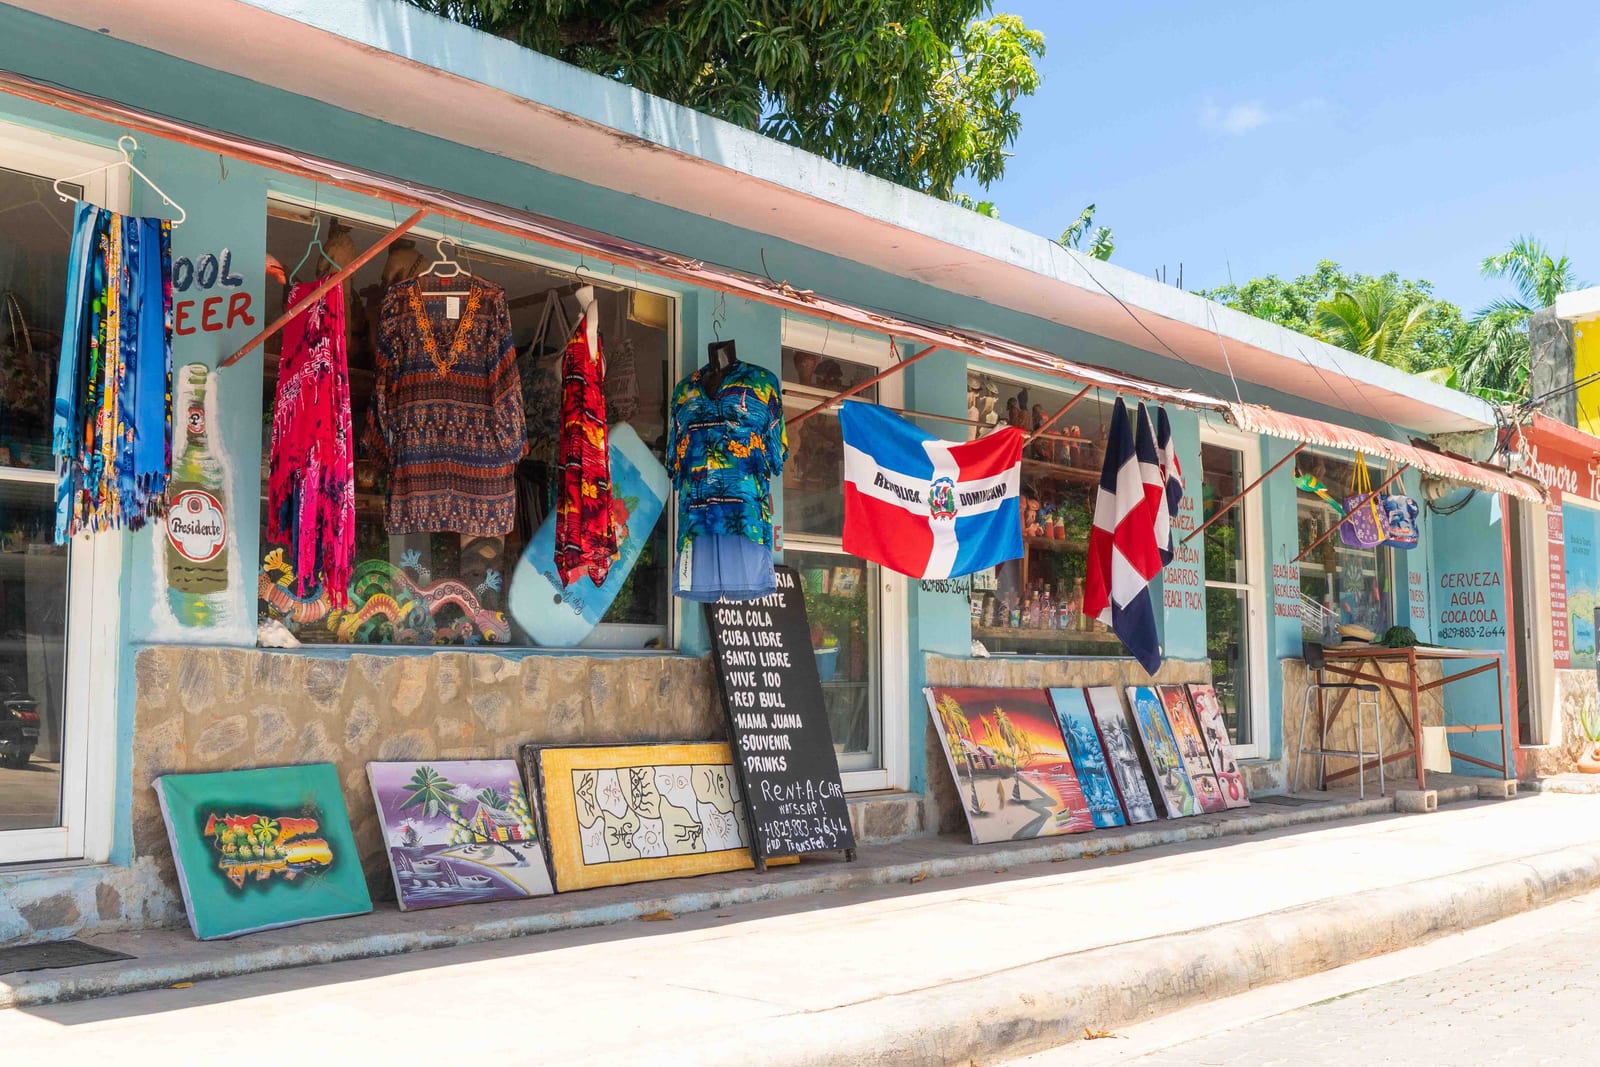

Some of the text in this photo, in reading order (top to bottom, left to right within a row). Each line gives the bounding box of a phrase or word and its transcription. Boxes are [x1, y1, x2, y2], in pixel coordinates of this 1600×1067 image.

[172, 248, 244, 293] OOL
[175, 292, 255, 336] EER
[171, 516, 221, 536] Presidente
[1169, 514, 1195, 531] ERVEZA
[1173, 546, 1200, 564] YACAN
[775, 572, 795, 589] RIA
[1163, 566, 1199, 587] CIGARROS
[1440, 571, 1501, 588] CERVEZA
[1163, 589, 1203, 611] BEACH PACK
[1450, 591, 1485, 606] AGUA
[718, 608, 773, 627] COCA COLA
[1440, 608, 1498, 624] COCA COLA
[722, 629, 784, 648] CUBA LIBRE
[726, 650, 792, 668] SANTO LIBRE
[729, 671, 782, 688] VIVE 100
[734, 691, 786, 708] RED BULL
[737, 713, 803, 729] MAMA JUANA
[742, 734, 792, 751] SOUVENIR
[746, 756, 788, 774] DRINKS
